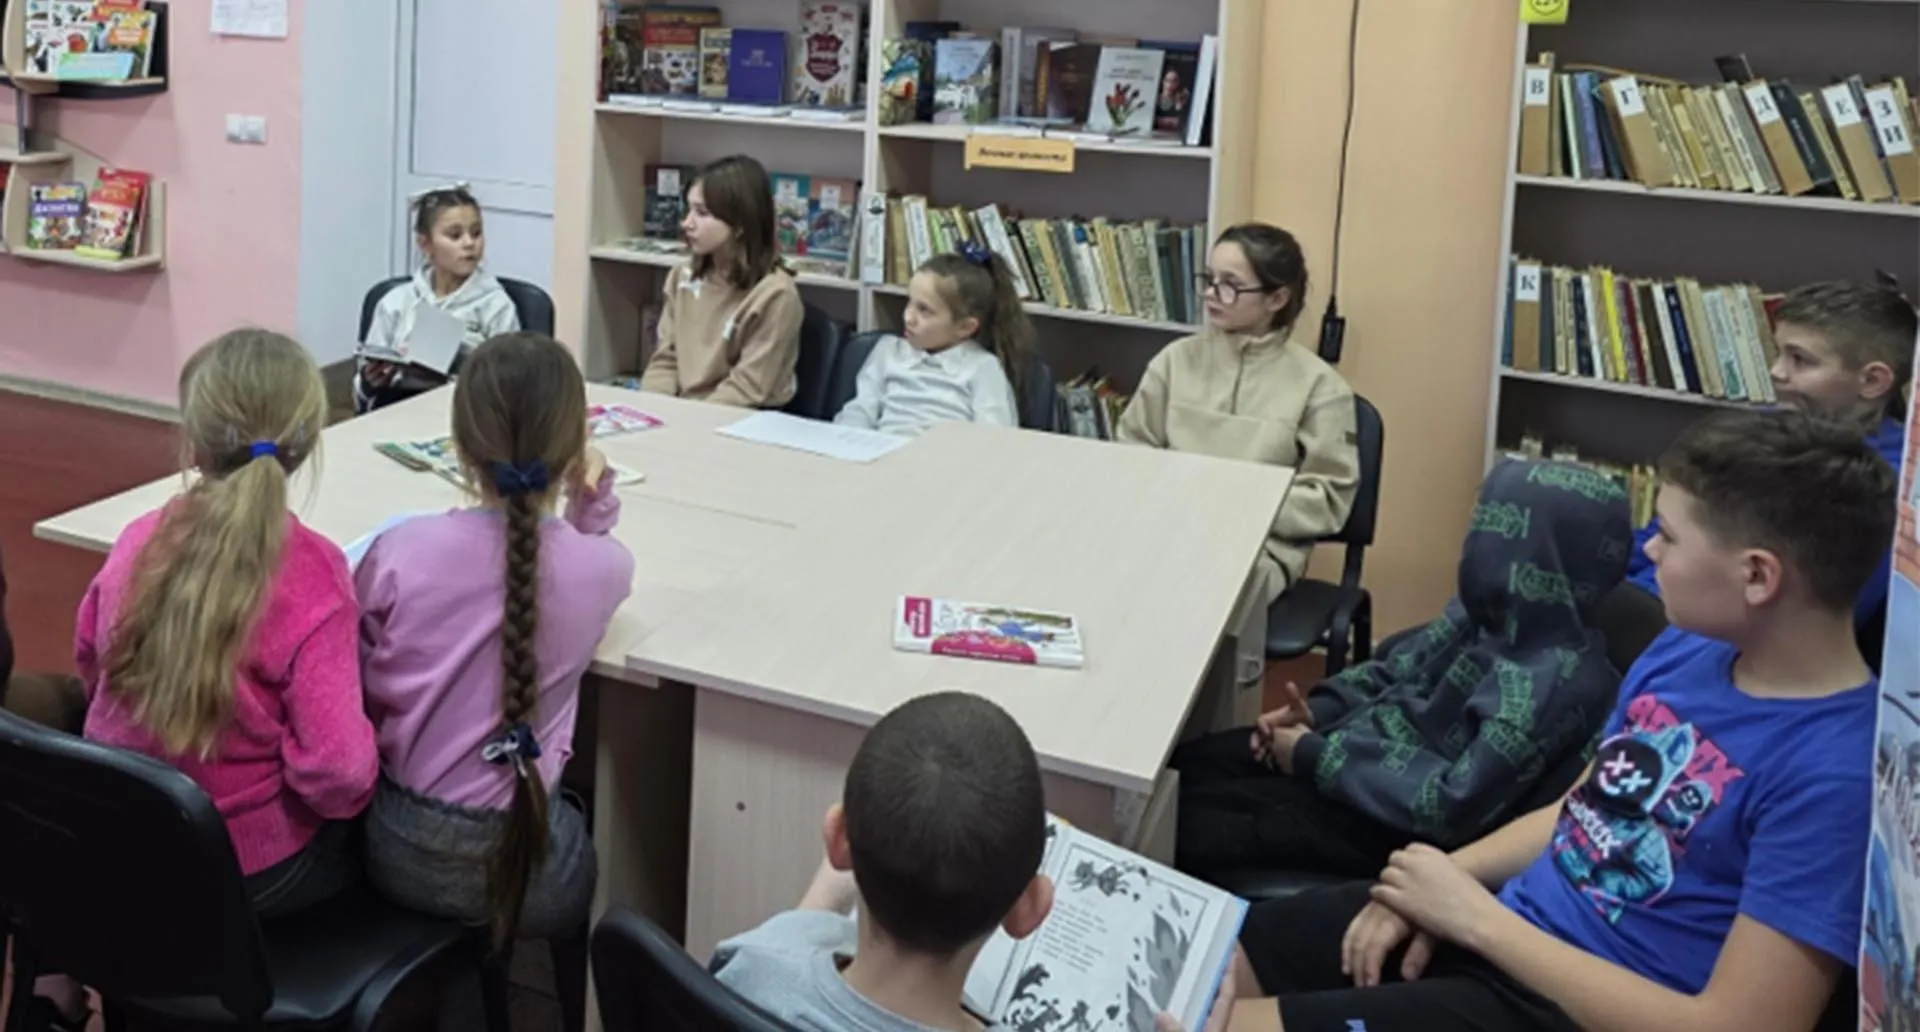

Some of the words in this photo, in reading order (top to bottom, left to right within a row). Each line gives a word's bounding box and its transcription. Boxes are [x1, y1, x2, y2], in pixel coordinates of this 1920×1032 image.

[1530, 79, 1545, 95] В
[1620, 87, 1635, 105] Г
[1521, 274, 1537, 291] К
